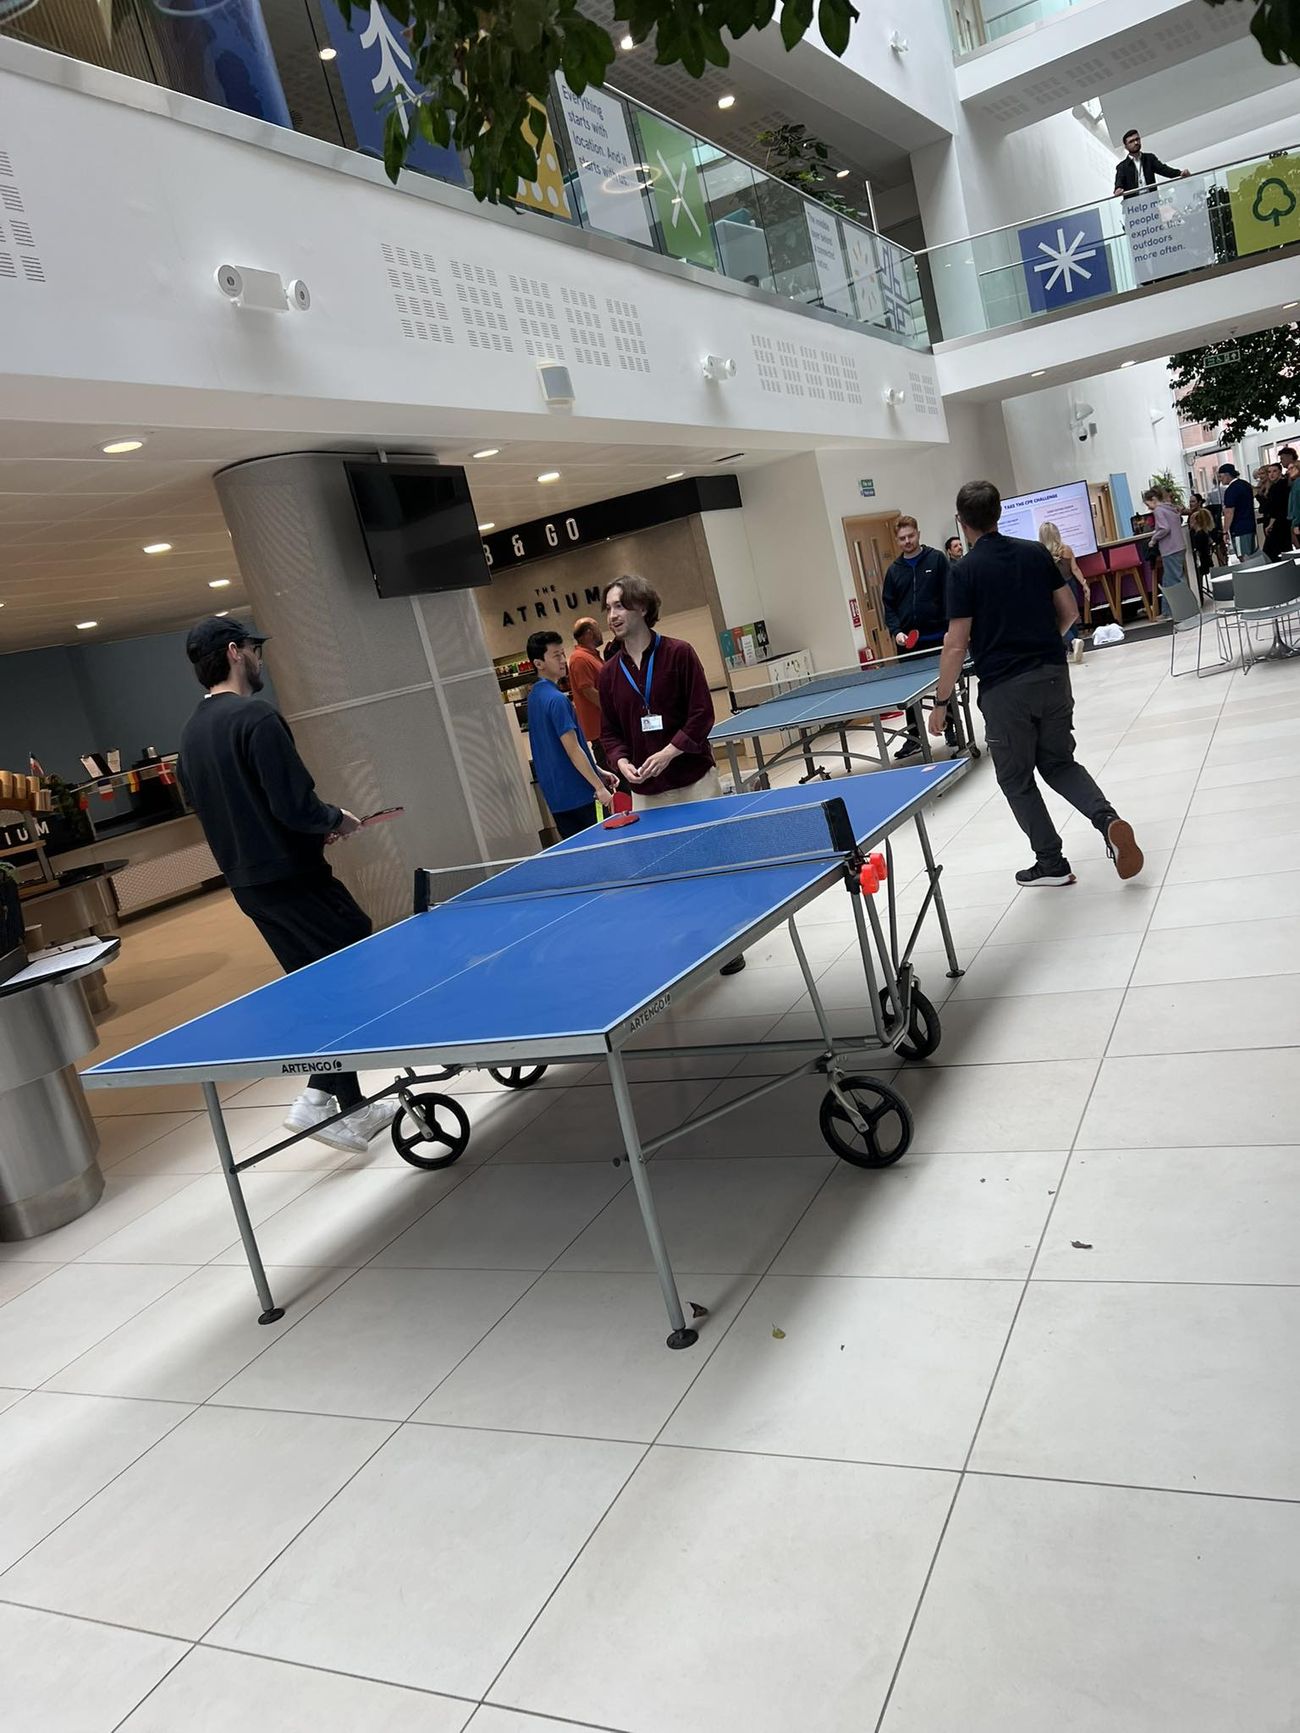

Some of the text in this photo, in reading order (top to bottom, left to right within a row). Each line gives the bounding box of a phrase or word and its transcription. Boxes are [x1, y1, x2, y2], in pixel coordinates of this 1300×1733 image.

[562, 85, 604, 121] Everything
[567, 111, 609, 139] starts with
[607, 146, 621, 164] And
[1127, 203, 1148, 214] Help
[1129, 213, 1160, 229] people
[1131, 225, 1164, 238] explore
[1133, 234, 1173, 250] outdoors
[1134, 244, 1186, 262] more often.
[511, 533, 525, 557] &
[545, 517, 580, 547] GO
[535, 584, 556, 596] THE
[503, 586, 601, 627] ATRIUM
[630, 1000, 665, 1032] ARTENGO
[282, 1061, 332, 1074] ARTENGO
